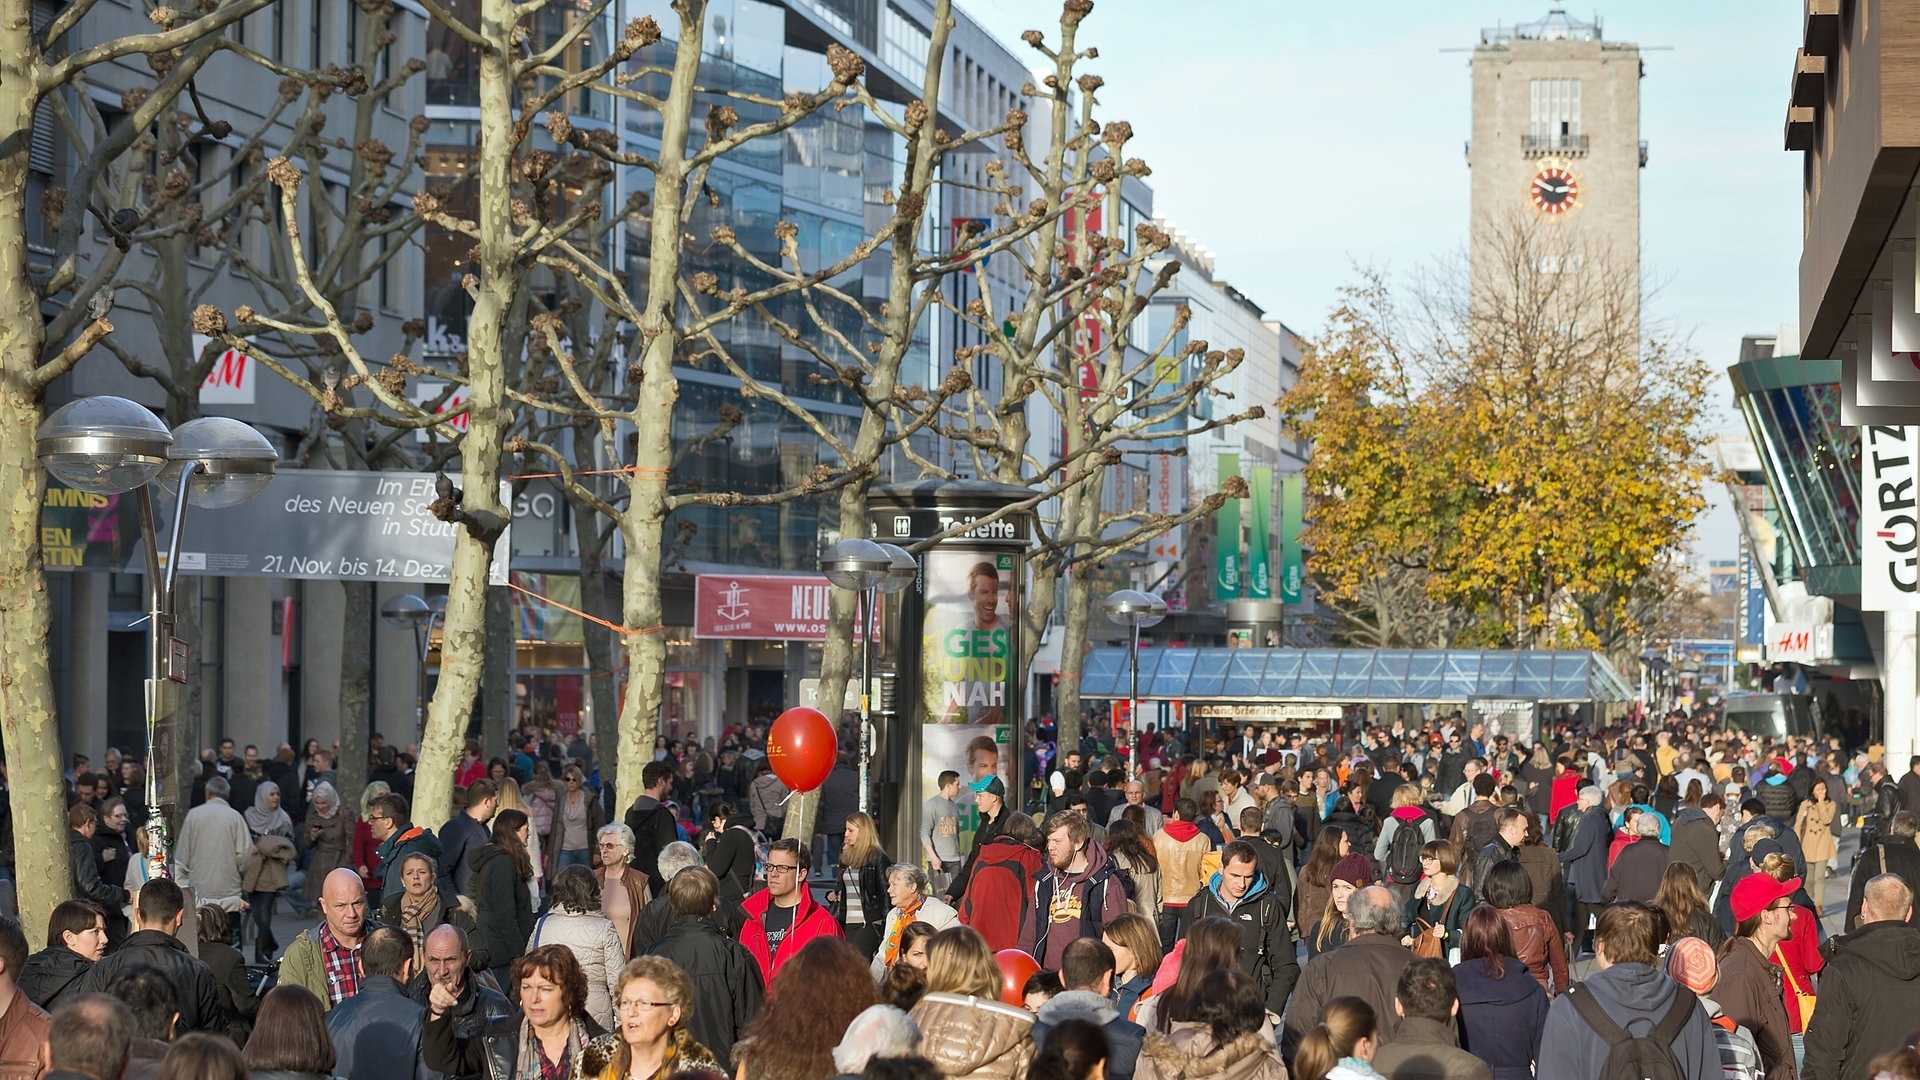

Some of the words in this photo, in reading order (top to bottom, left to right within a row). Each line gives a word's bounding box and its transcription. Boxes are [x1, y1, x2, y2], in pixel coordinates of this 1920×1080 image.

[377, 478, 399, 496] Im
[284, 494, 322, 513] des
[328, 496, 395, 516] Neuen
[382, 517, 401, 536] in
[407, 518, 458, 537] Stutt
[938, 515, 1015, 539] Toilette
[261, 555, 285, 573] 21.
[289, 556, 333, 575] Nov.
[338, 557, 368, 576] bis
[375, 558, 399, 577] 14.
[403, 559, 447, 578] Dez.
[943, 628, 1007, 659] GES
[943, 655, 1007, 682] UND
[943, 680, 1006, 707] NAH
